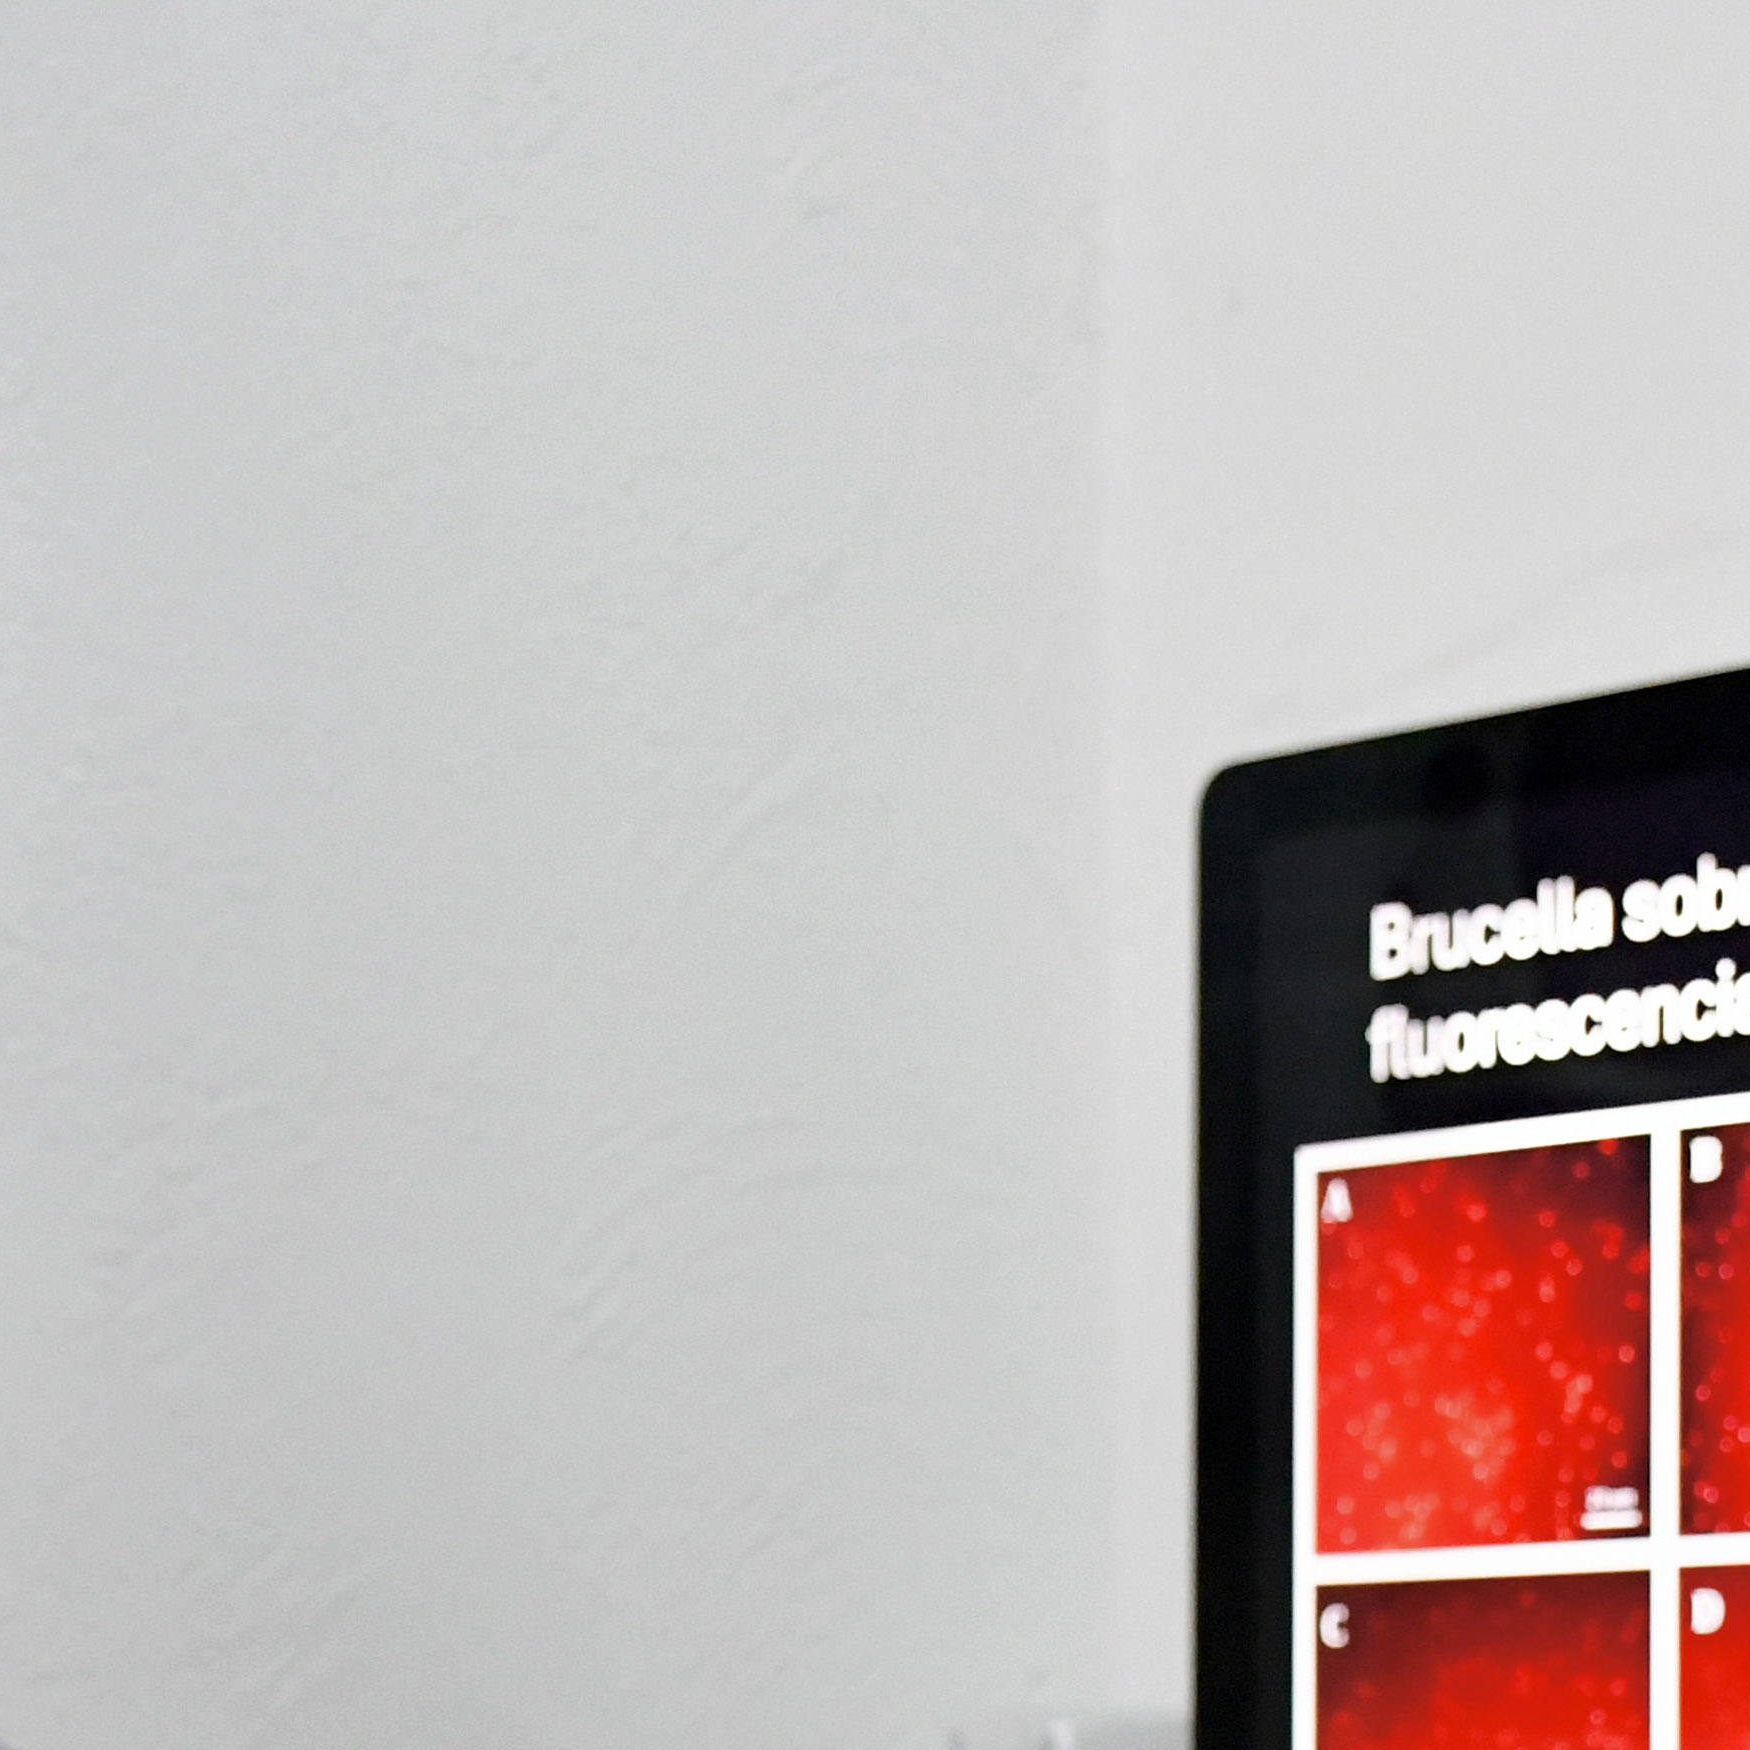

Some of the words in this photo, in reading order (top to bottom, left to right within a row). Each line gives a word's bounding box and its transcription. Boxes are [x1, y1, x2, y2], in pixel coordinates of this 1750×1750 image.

[1370, 876, 1614, 981] Brucella
[1320, 1177, 1354, 1223] A
[1319, 1602, 1349, 1649] C
[1690, 1587, 1726, 1635] D
